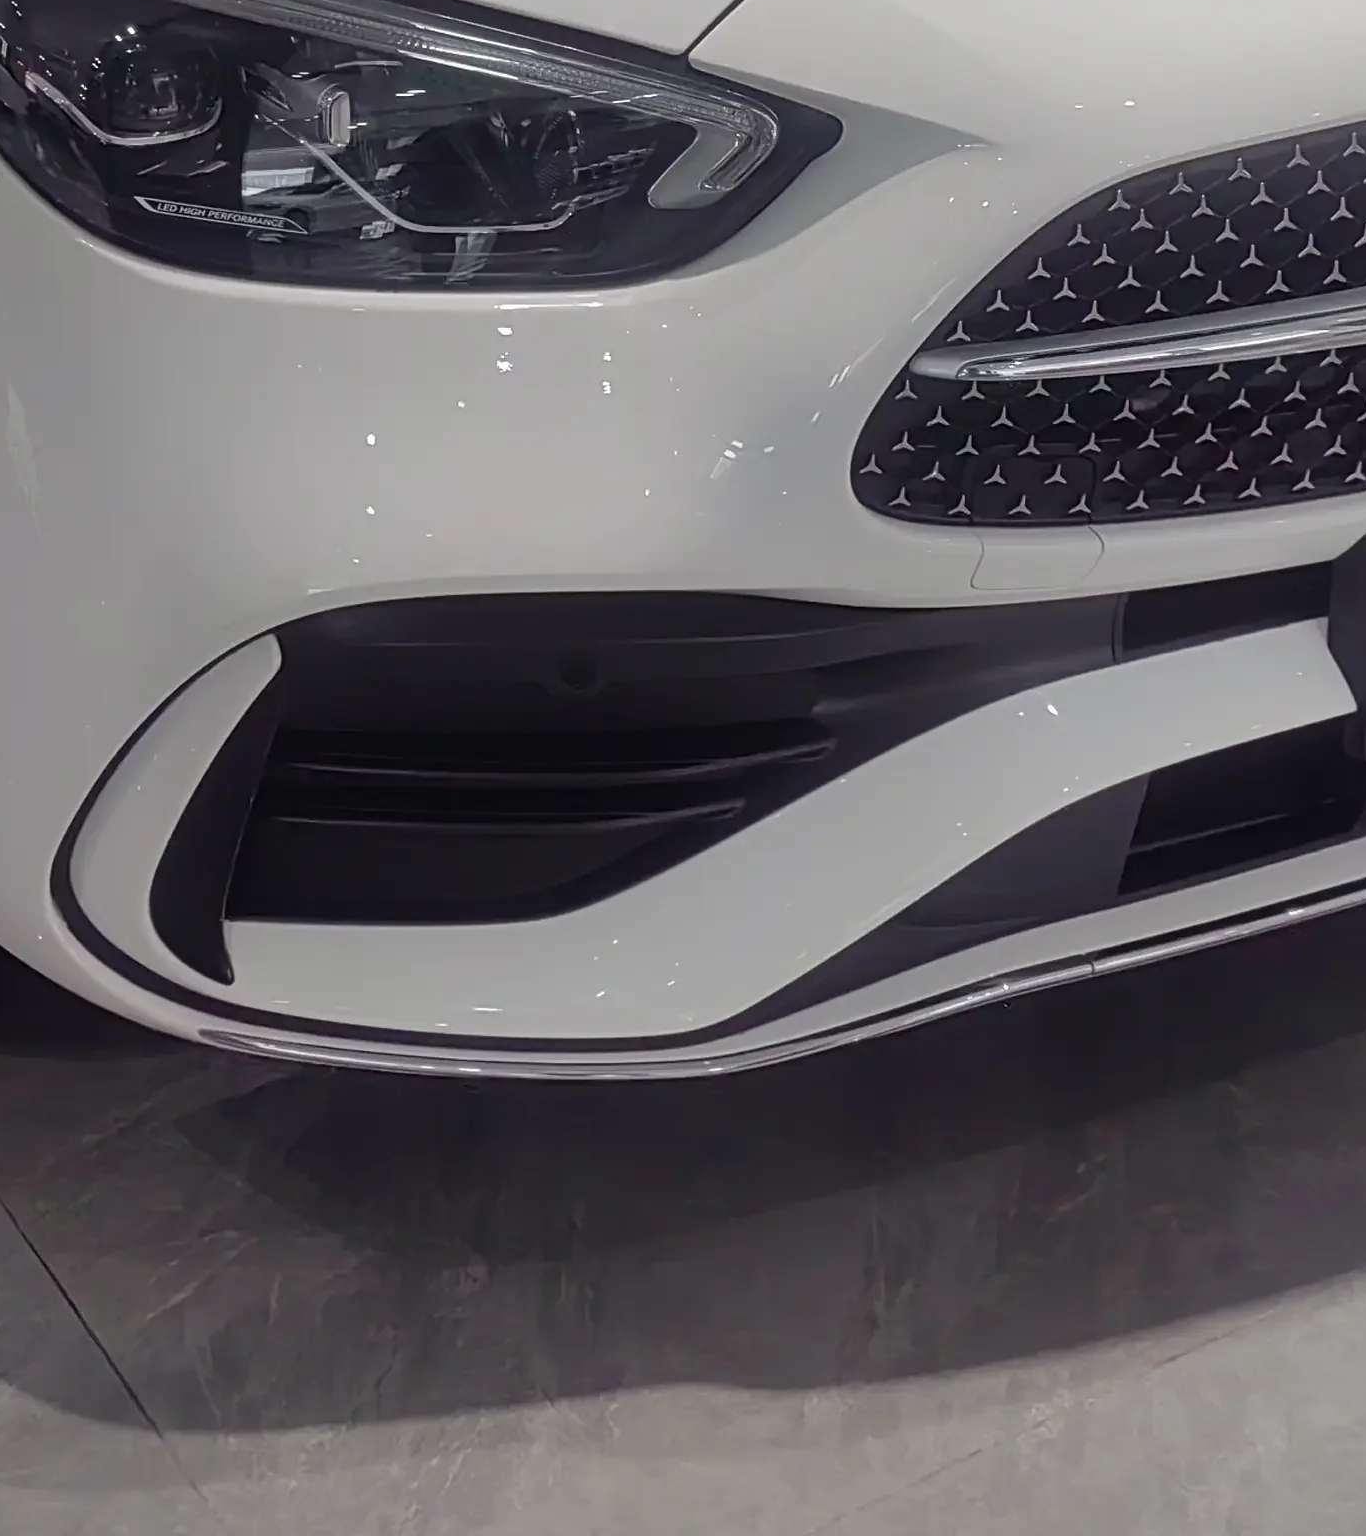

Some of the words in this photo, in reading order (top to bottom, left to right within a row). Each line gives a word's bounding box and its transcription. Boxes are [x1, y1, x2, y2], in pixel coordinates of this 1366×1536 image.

[156, 202, 178, 214] LED
[178, 206, 207, 218] HIGH
[207, 209, 286, 229] PERFORMANCE
